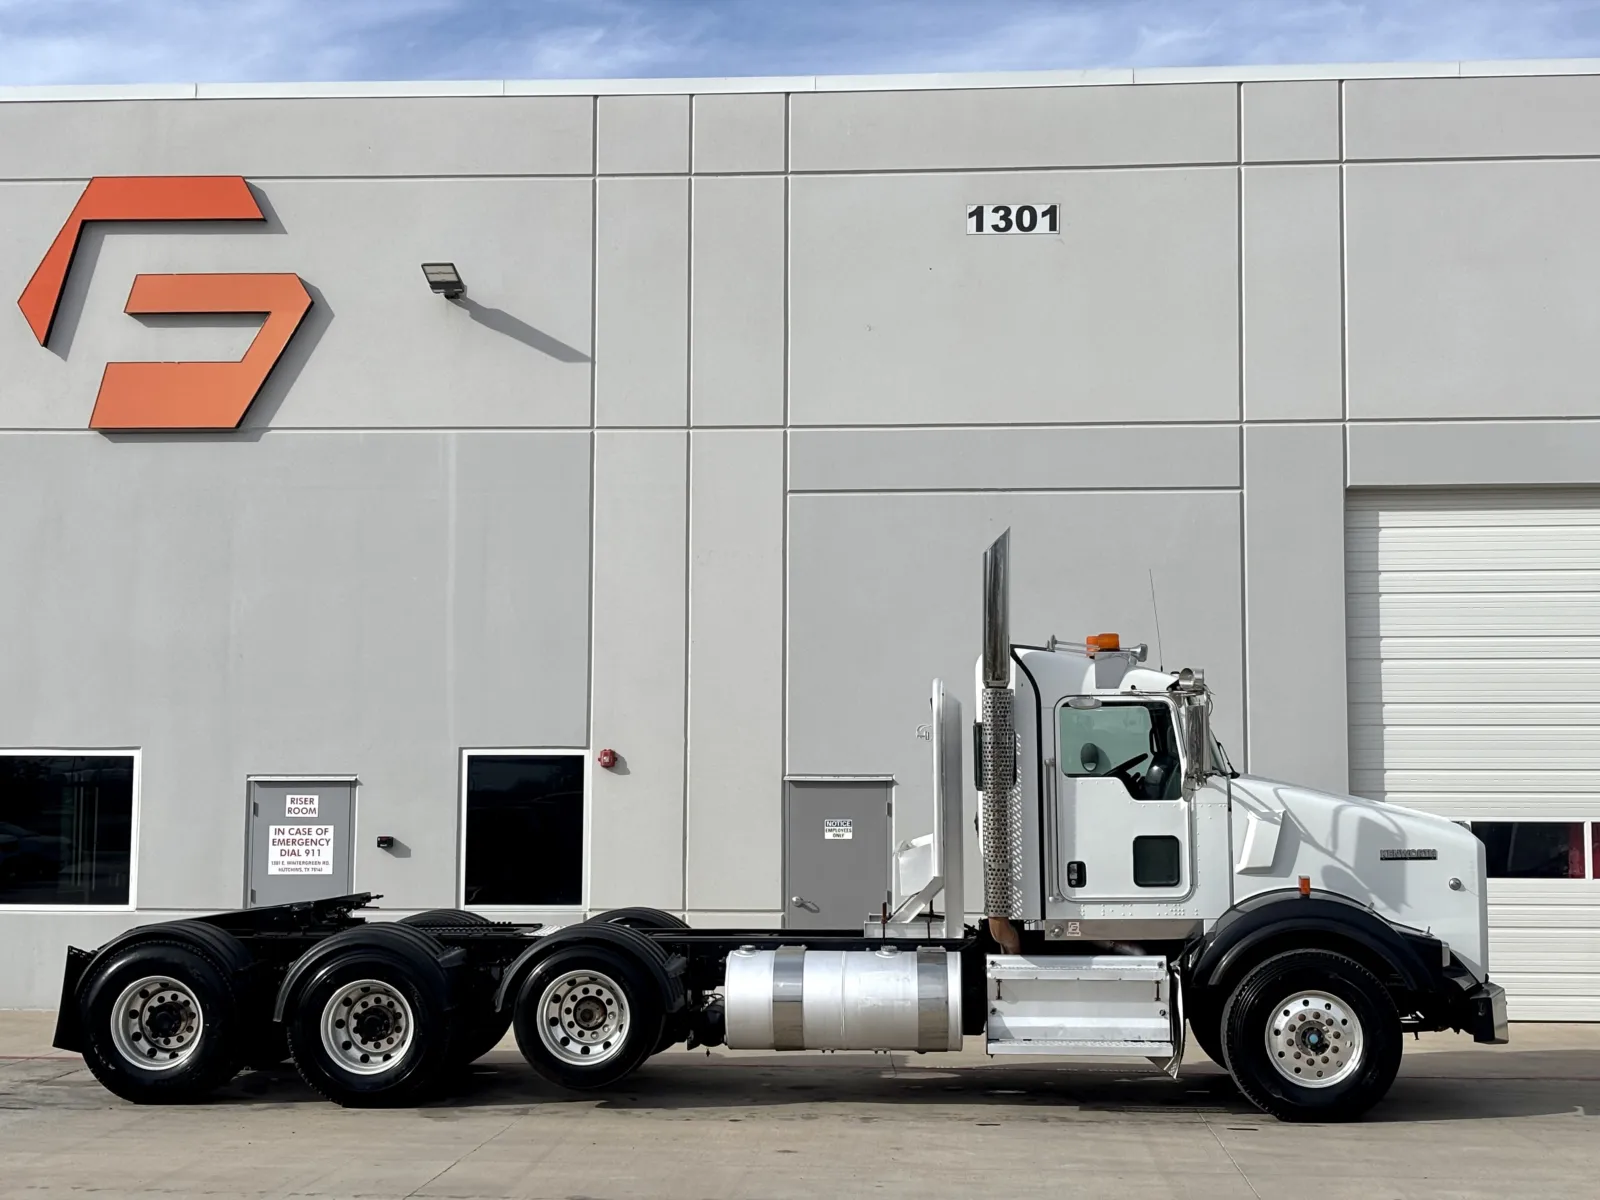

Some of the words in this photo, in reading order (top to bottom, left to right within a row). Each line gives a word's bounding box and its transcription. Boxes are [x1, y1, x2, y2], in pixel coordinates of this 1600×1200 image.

[968, 204, 1058, 232] 1301
[290, 797, 315, 805] RISER
[287, 807, 316, 815] ROOM
[274, 828, 285, 836] IN
[288, 828, 312, 836] CASE
[315, 828, 329, 836] OF
[272, 838, 331, 846] EMERGENCY
[280, 849, 302, 857] DIAL
[304, 849, 321, 857] 911
[1380, 849, 1437, 860] KENWORTH
